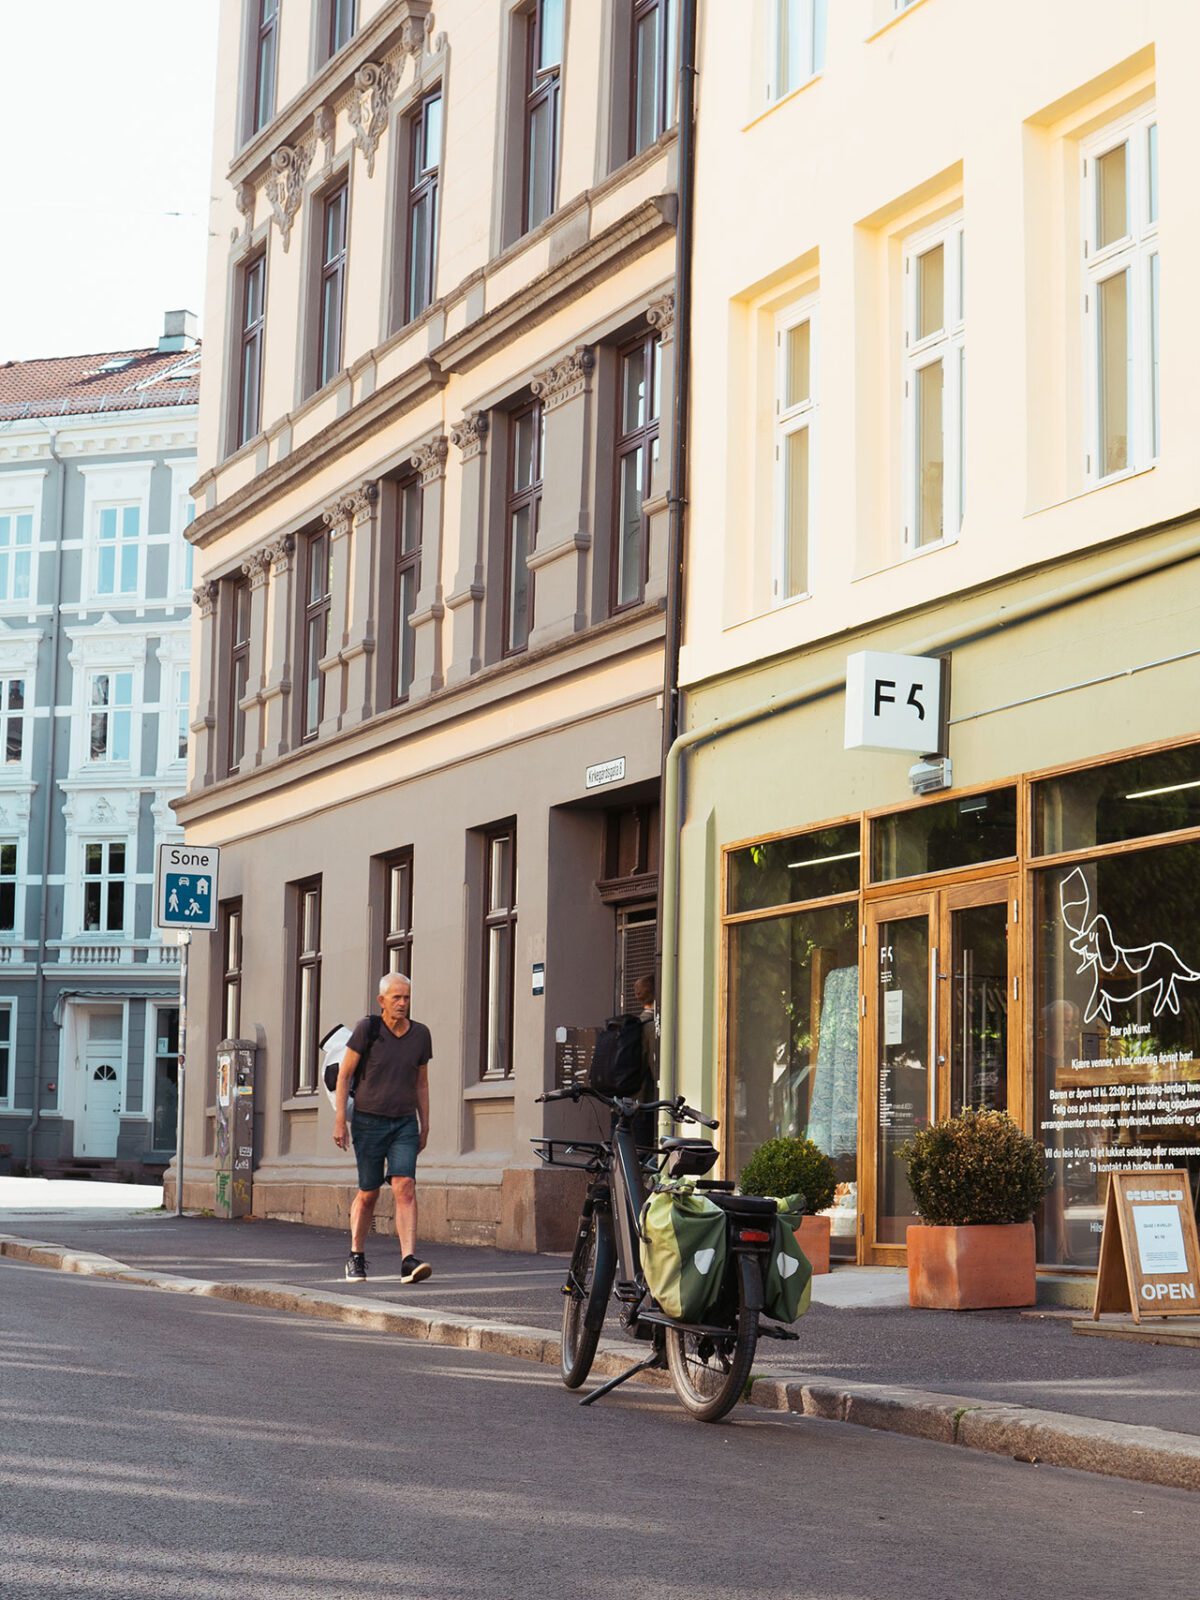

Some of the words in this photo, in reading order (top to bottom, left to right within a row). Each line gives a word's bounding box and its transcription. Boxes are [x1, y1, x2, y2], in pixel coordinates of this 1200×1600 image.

[170, 850, 209, 866] Sone
[1110, 1026, 1122, 1036] Bar
[1123, 1024, 1131, 1038] på
[1133, 1023, 1150, 1034] Kuro!
[1072, 1058, 1090, 1071] Kjære
[1091, 1058, 1114, 1068] venner,
[1115, 1056, 1120, 1066] vi
[1122, 1055, 1133, 1065] har
[1133, 1053, 1157, 1066] endelig
[1159, 1051, 1178, 1064] åpnet
[1179, 1051, 1193, 1062] bar!
[1050, 1090, 1067, 1100] Baren
[1068, 1090, 1076, 1098] er
[1076, 1086, 1092, 1100] åpen
[1109, 1085, 1126, 1096] 23:00
[1127, 1084, 1135, 1097] på
[1136, 1082, 1186, 1096] torsdag-lørdag
[1053, 1104, 1066, 1116] Følg
[1067, 1105, 1078, 1114] oss
[1080, 1102, 1087, 1115] på
[1089, 1102, 1120, 1114] Instagram
[1121, 1101, 1130, 1111] for
[1132, 1100, 1136, 1111] å
[1137, 1100, 1155, 1110] holde
[1157, 1099, 1170, 1112] deg
[1041, 1119, 1085, 1131] arrangementer
[1086, 1119, 1100, 1128] som
[1101, 1116, 1116, 1129] quiz,
[1118, 1115, 1150, 1130] vinylkveld,
[1152, 1114, 1184, 1125] konserter
[1185, 1116, 1195, 1126] og
[1054, 1148, 1061, 1158] du
[1062, 1148, 1073, 1158] leie
[1074, 1148, 1089, 1158] Kuro
[1097, 1147, 1104, 1157] et
[1105, 1146, 1126, 1157] lukket
[1126, 1146, 1151, 1158] selskap
[1152, 1145, 1167, 1156] eller
[1089, 1162, 1096, 1172] Ta
[1098, 1162, 1122, 1172] kontakt
[1142, 1283, 1195, 1300] OPEN
